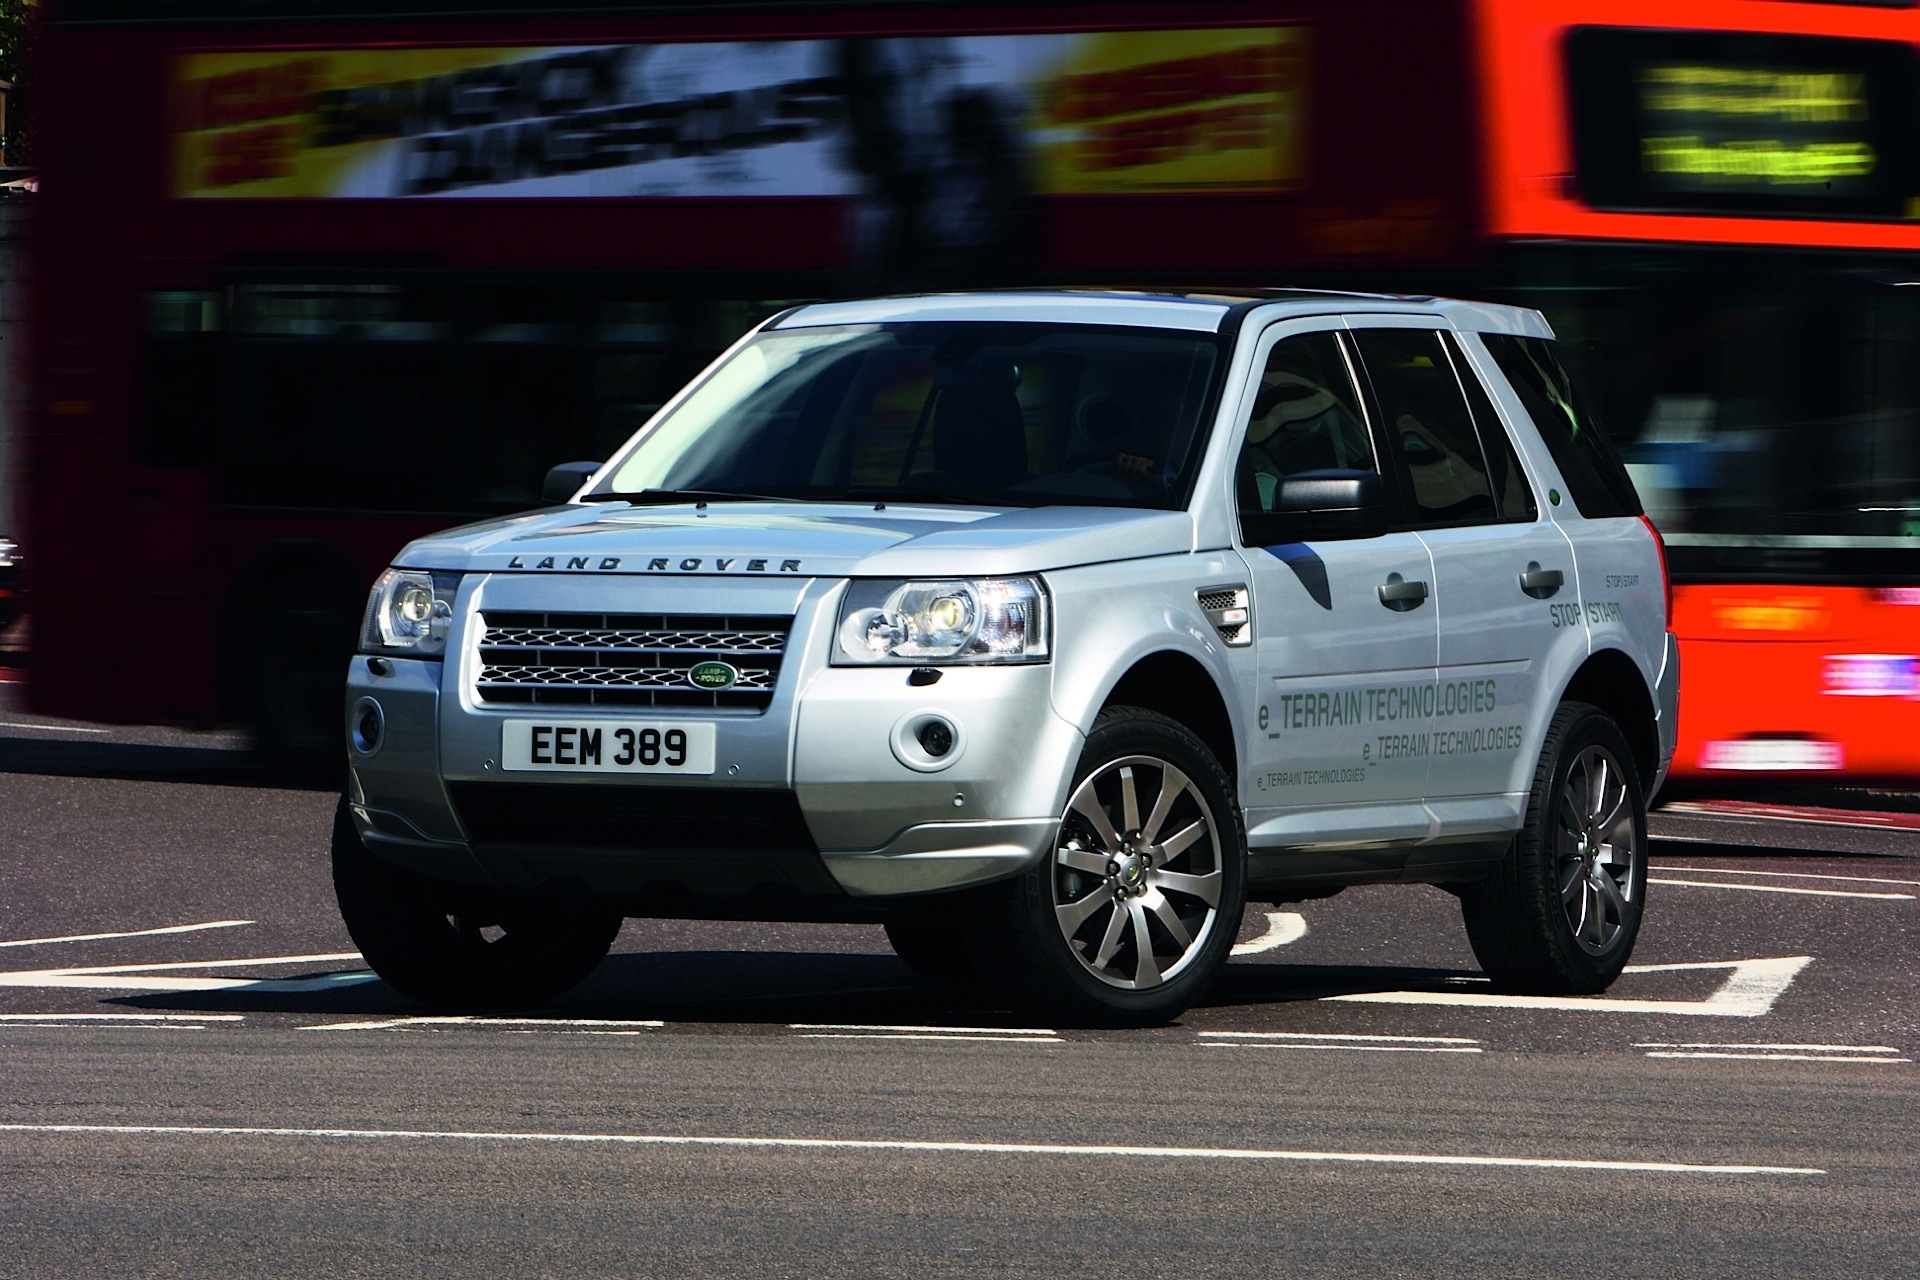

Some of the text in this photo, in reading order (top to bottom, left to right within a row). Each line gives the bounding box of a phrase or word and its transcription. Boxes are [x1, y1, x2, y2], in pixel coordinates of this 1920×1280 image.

[508, 556, 802, 572] LAND ROVER
[1606, 574, 1639, 589] STOP/START
[1549, 599, 1625, 628] STOP/START
[1259, 678, 1496, 739] e_TERRAIN TECHNOLOGIES
[531, 726, 687, 767] EEM 389
[1363, 724, 1523, 766] e_TERRAIN TECHNOLOGIES
[1303, 767, 1366, 786] TECHNOLOGIES
